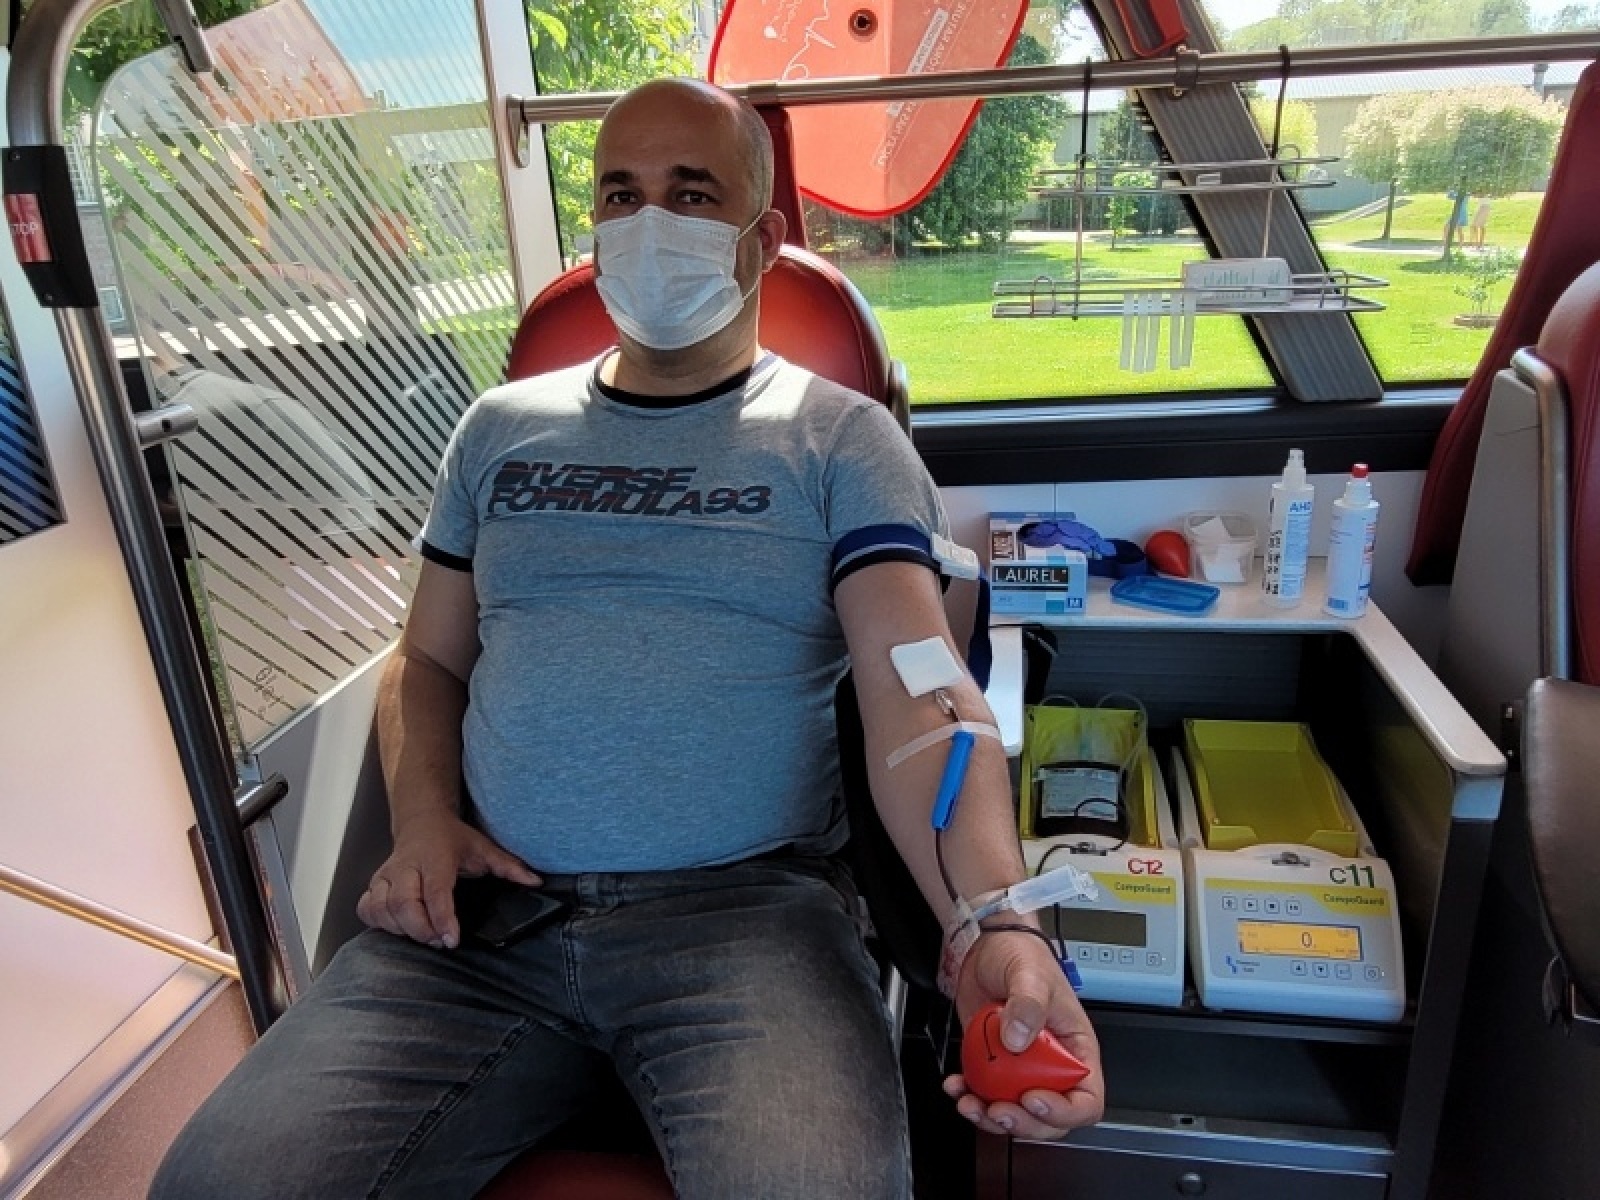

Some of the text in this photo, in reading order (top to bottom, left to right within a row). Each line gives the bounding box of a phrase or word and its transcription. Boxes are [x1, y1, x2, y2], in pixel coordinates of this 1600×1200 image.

[493, 461, 697, 492] DIVERSE
[994, 566, 1060, 583] LAUREL
[1127, 858, 1164, 875] C12
[1114, 881, 1171, 895] CompoGuard
[1323, 893, 1385, 906] CompoGuard
